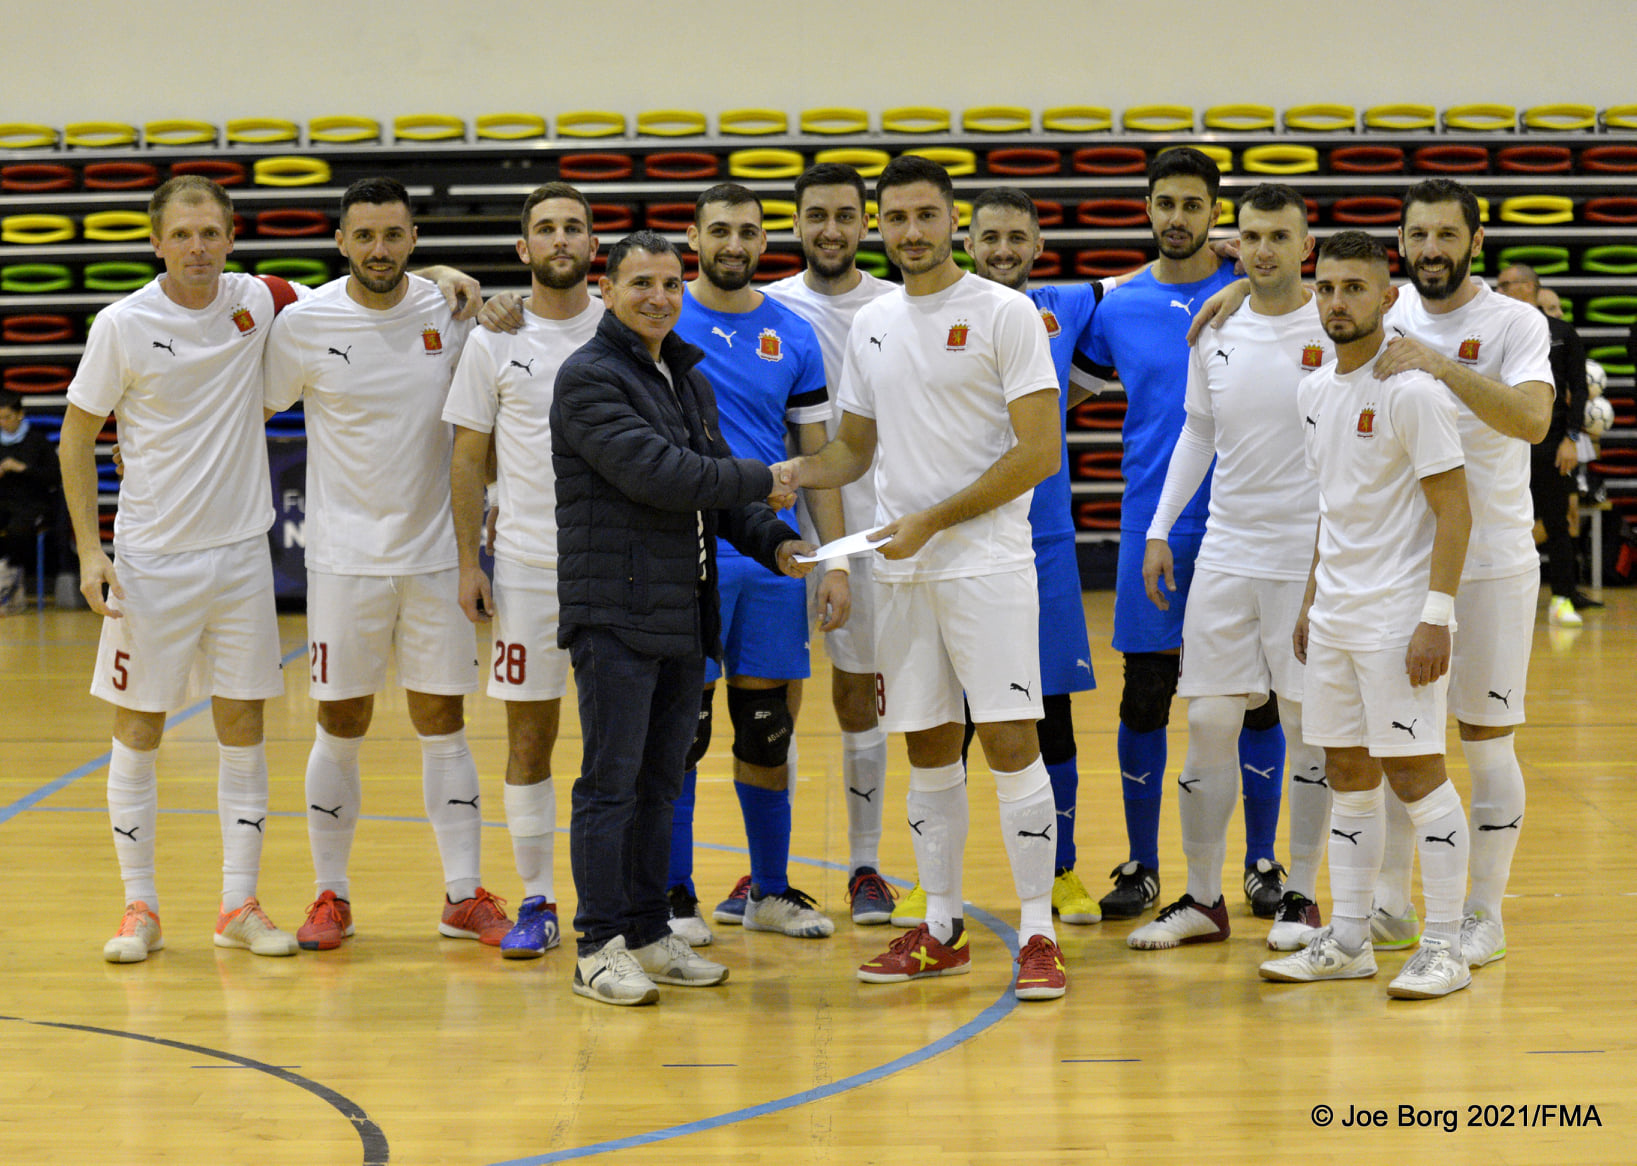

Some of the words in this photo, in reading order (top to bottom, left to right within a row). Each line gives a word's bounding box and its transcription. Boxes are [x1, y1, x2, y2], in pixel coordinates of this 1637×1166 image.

[112, 649, 130, 691] 5
[311, 640, 328, 684] 21
[494, 639, 527, 685] 28
